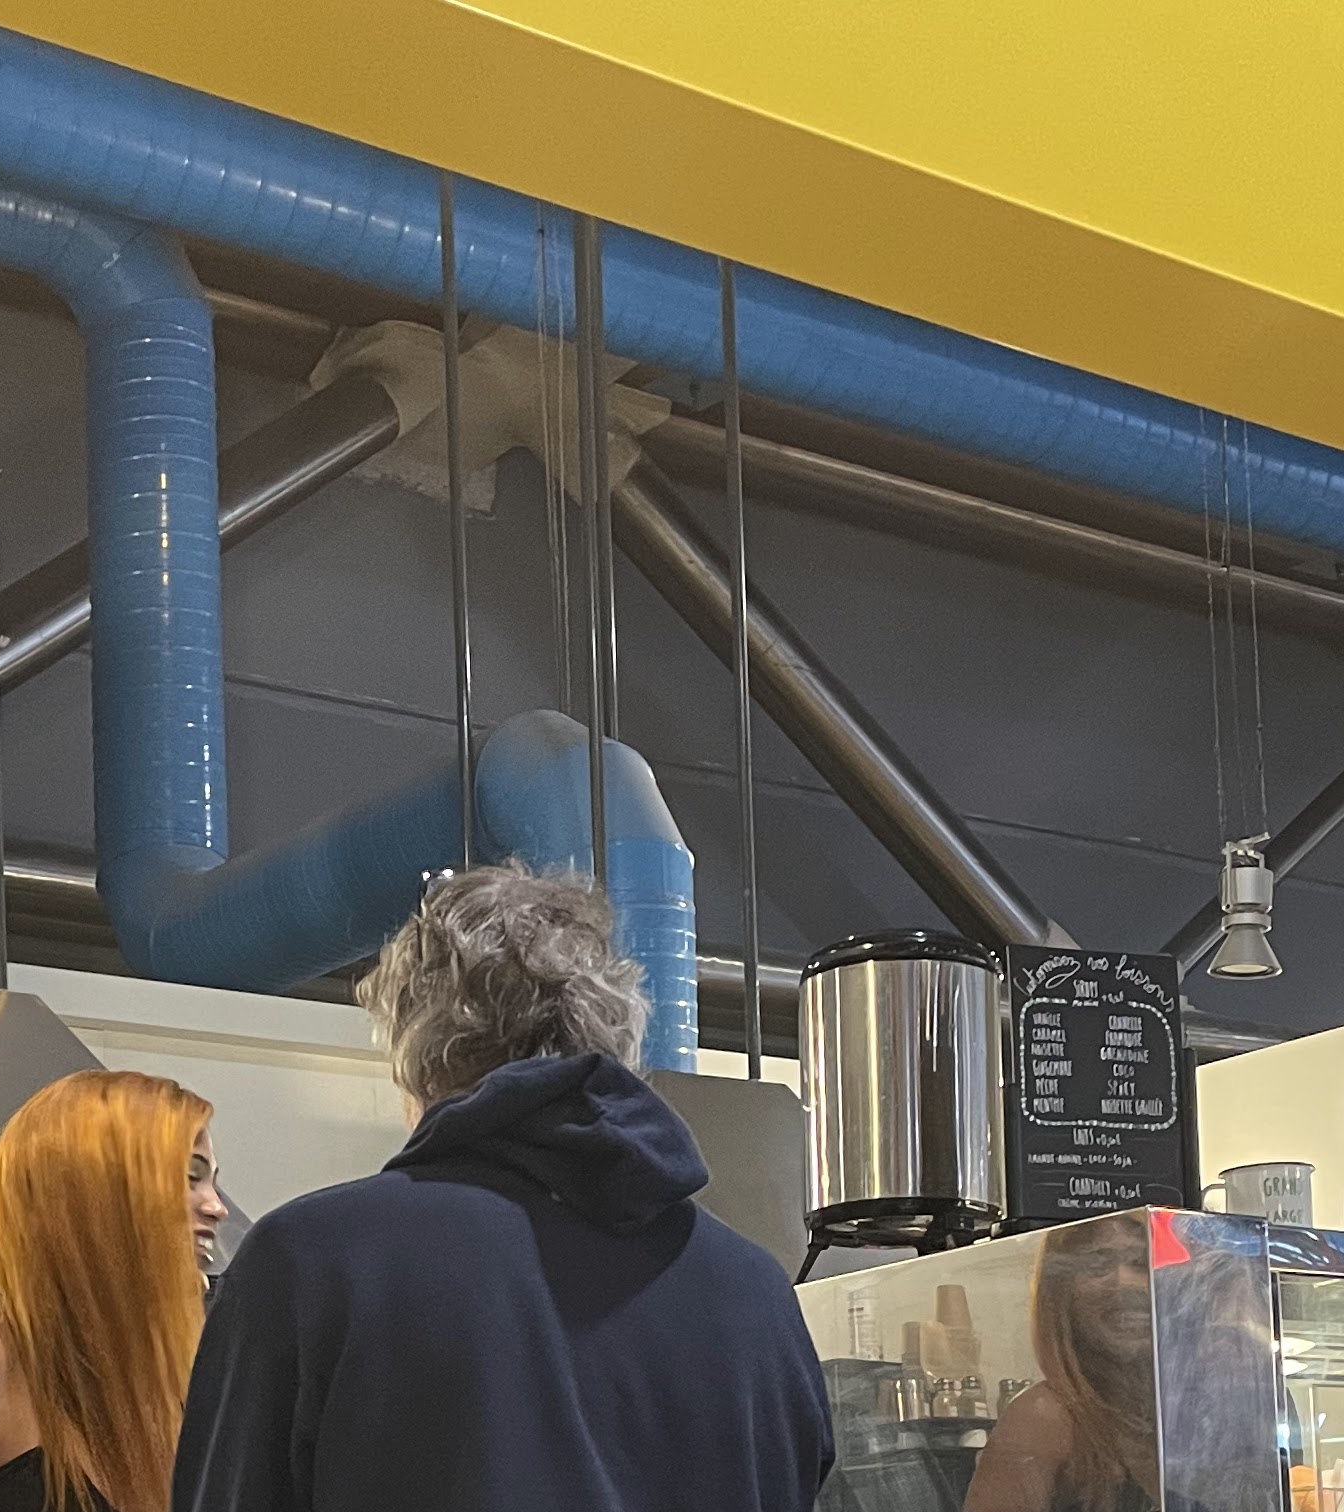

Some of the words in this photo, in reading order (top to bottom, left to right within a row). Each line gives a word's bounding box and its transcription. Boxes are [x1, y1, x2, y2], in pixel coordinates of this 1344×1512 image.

[1114, 954, 1175, 1013] boissons
[1032, 1028, 1067, 1042] CARAMEL
[1112, 1064, 1135, 1078] COCO
